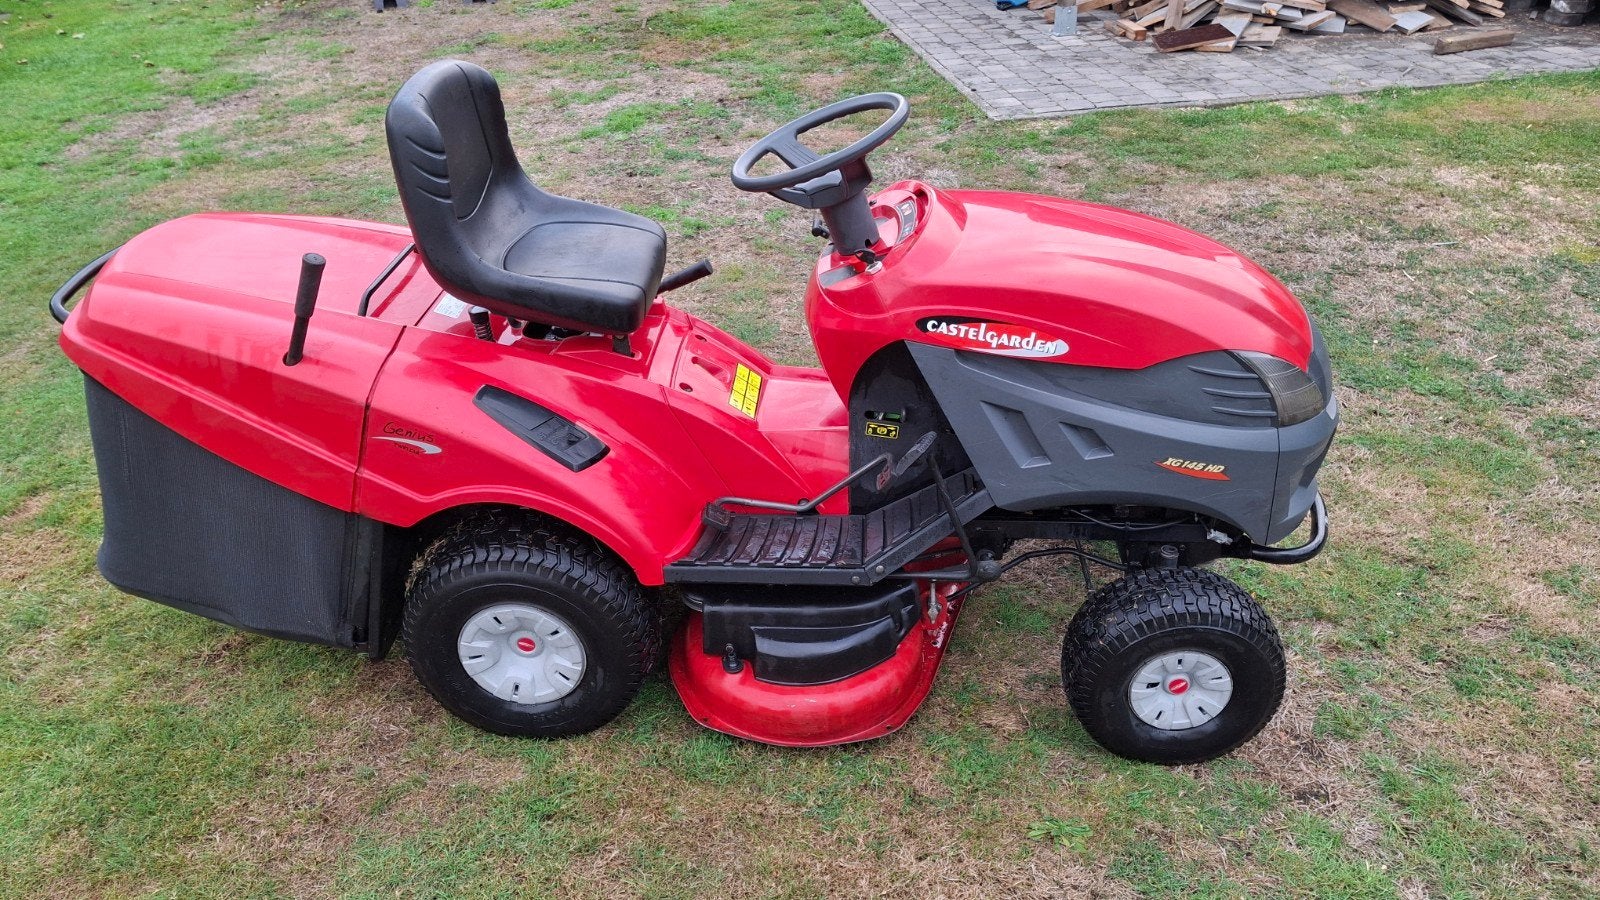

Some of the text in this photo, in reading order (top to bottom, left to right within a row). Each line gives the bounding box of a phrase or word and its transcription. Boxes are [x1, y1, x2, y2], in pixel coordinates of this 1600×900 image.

[383, 421, 434, 442] Genius
[1163, 457, 1225, 473] XG 145 HD
